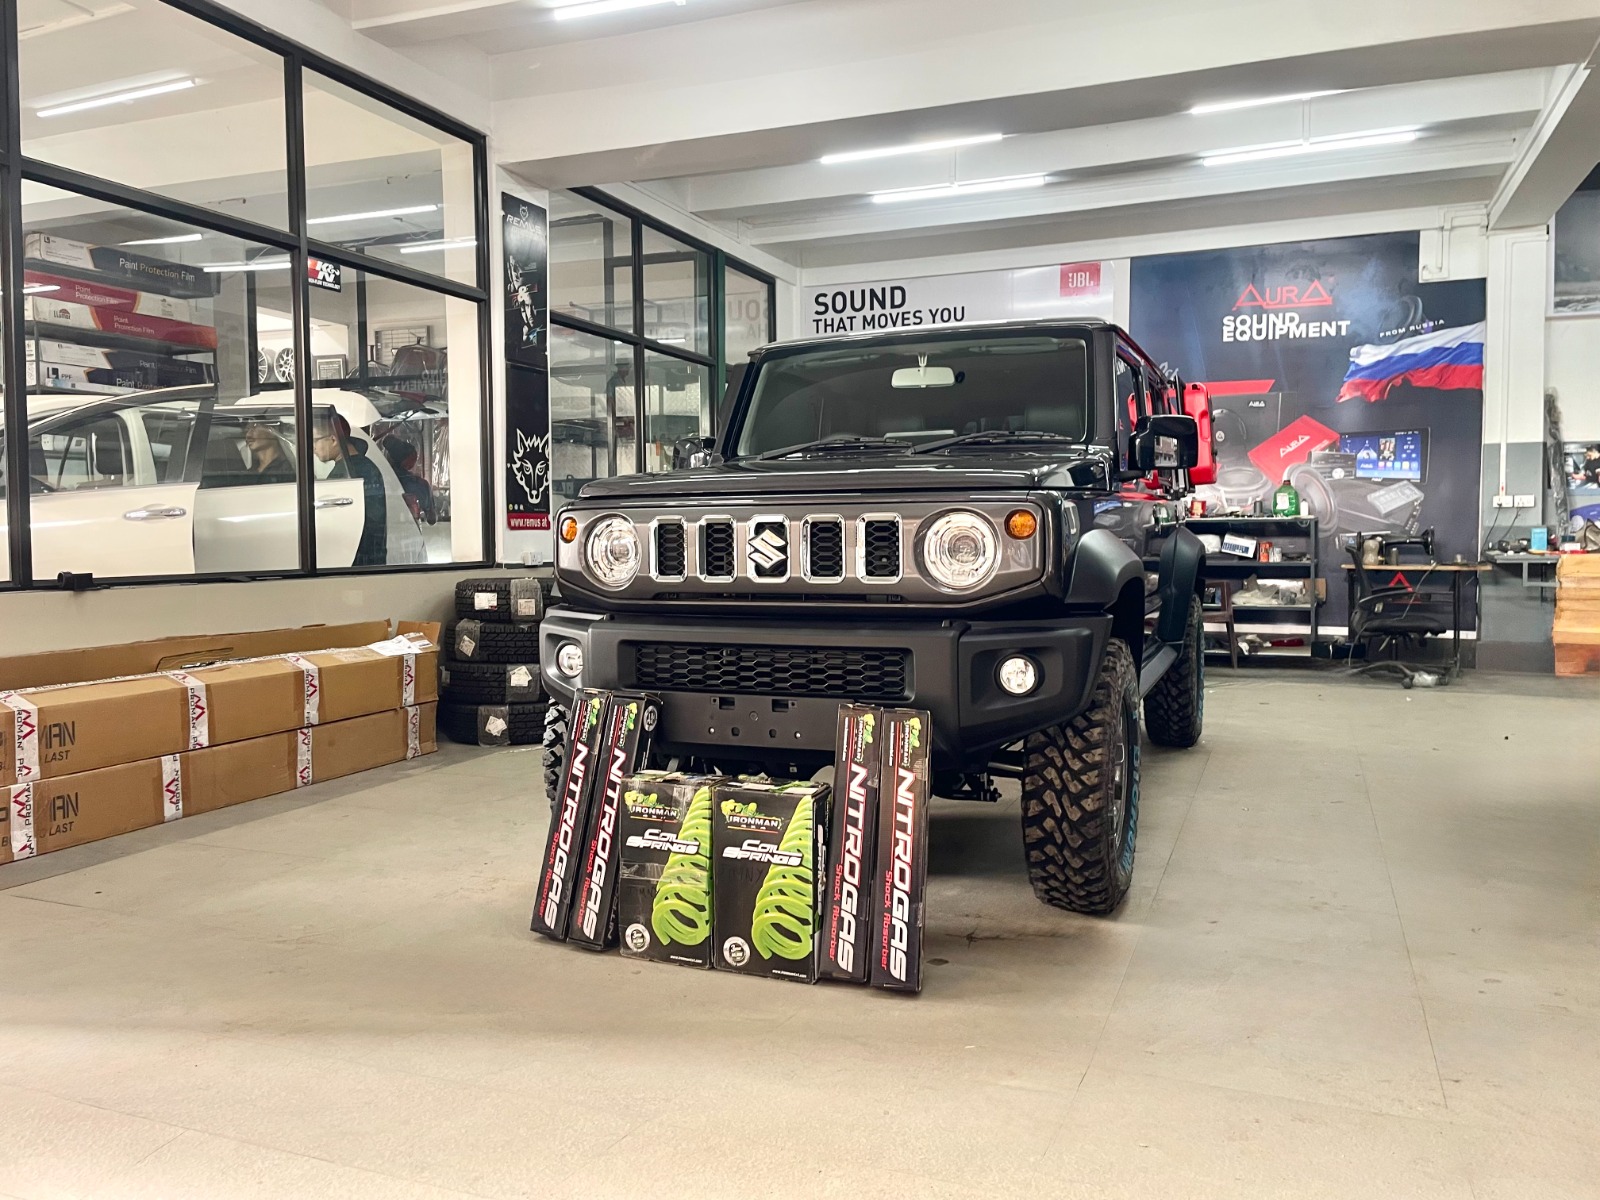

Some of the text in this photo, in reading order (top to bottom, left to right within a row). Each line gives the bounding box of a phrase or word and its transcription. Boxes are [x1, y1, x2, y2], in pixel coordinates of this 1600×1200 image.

[506, 214, 542, 235] REMUS
[119, 257, 196, 282] Paint Protection Film
[1068, 271, 1094, 288] JBL
[814, 285, 907, 316] SOUND
[813, 306, 966, 334] THAT MOVES YOU
[1222, 312, 1300, 330] SOUND
[1222, 320, 1351, 342] EQUIPMENT
[1379, 318, 1445, 338] FROM RUSSIA
[116, 378, 135, 389] Paint
[1279, 434, 1311, 458] AURA
[189, 687, 197, 731] PROMAN
[44, 750, 71, 764] LAST
[173, 769, 181, 812] PROMAN
[631, 806, 678, 818] IRONMAN
[728, 815, 779, 828] IRONMAN
[49, 821, 75, 838] LAST
[543, 741, 590, 930] NITROGAS
[582, 747, 627, 941] NITROGAS
[538, 831, 560, 918] Shock Absorber
[837, 762, 868, 974] NITROGAS
[889, 766, 917, 983] NITROGAS
[577, 838, 598, 928] Shock Absorber
[829, 863, 843, 962] Shock Absorber
[880, 869, 893, 970] Shock Absorber
